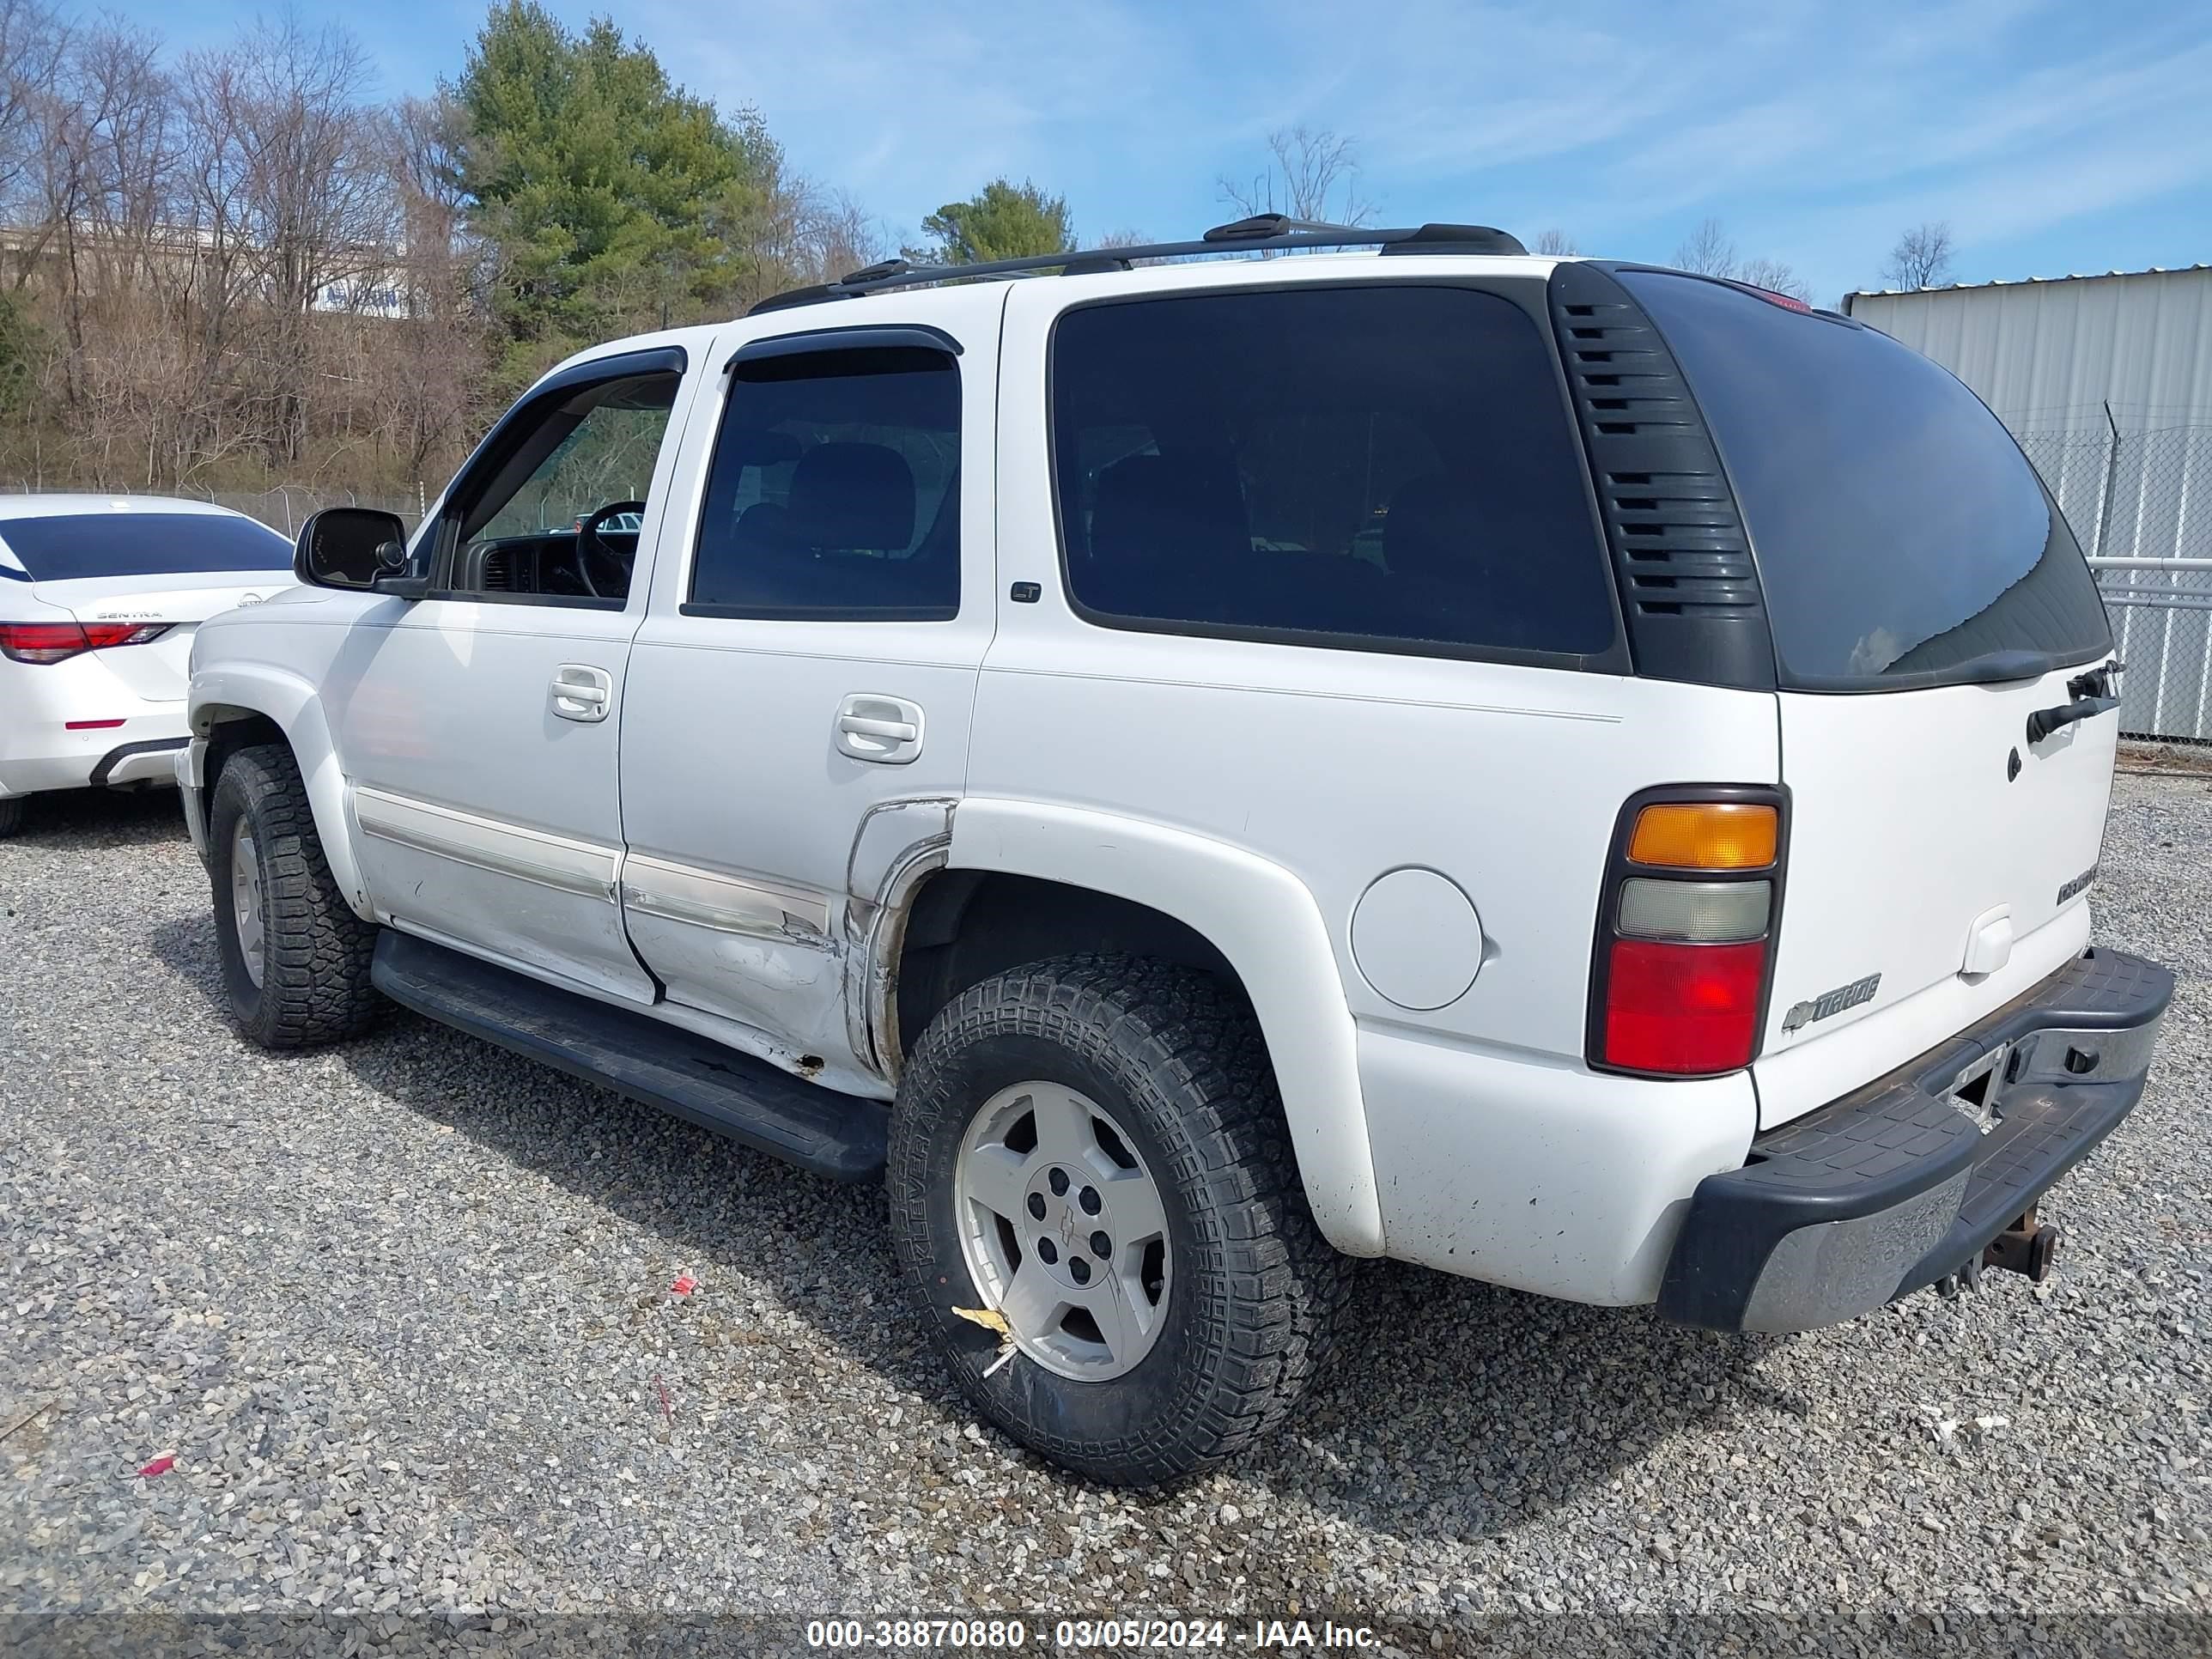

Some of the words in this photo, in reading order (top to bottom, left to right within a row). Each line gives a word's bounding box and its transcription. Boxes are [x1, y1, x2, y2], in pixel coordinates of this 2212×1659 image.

[96, 611, 163, 620] SENTRA
[1814, 973, 1881, 1022] TAHOE
[908, 1133, 936, 1267] KLEVER
